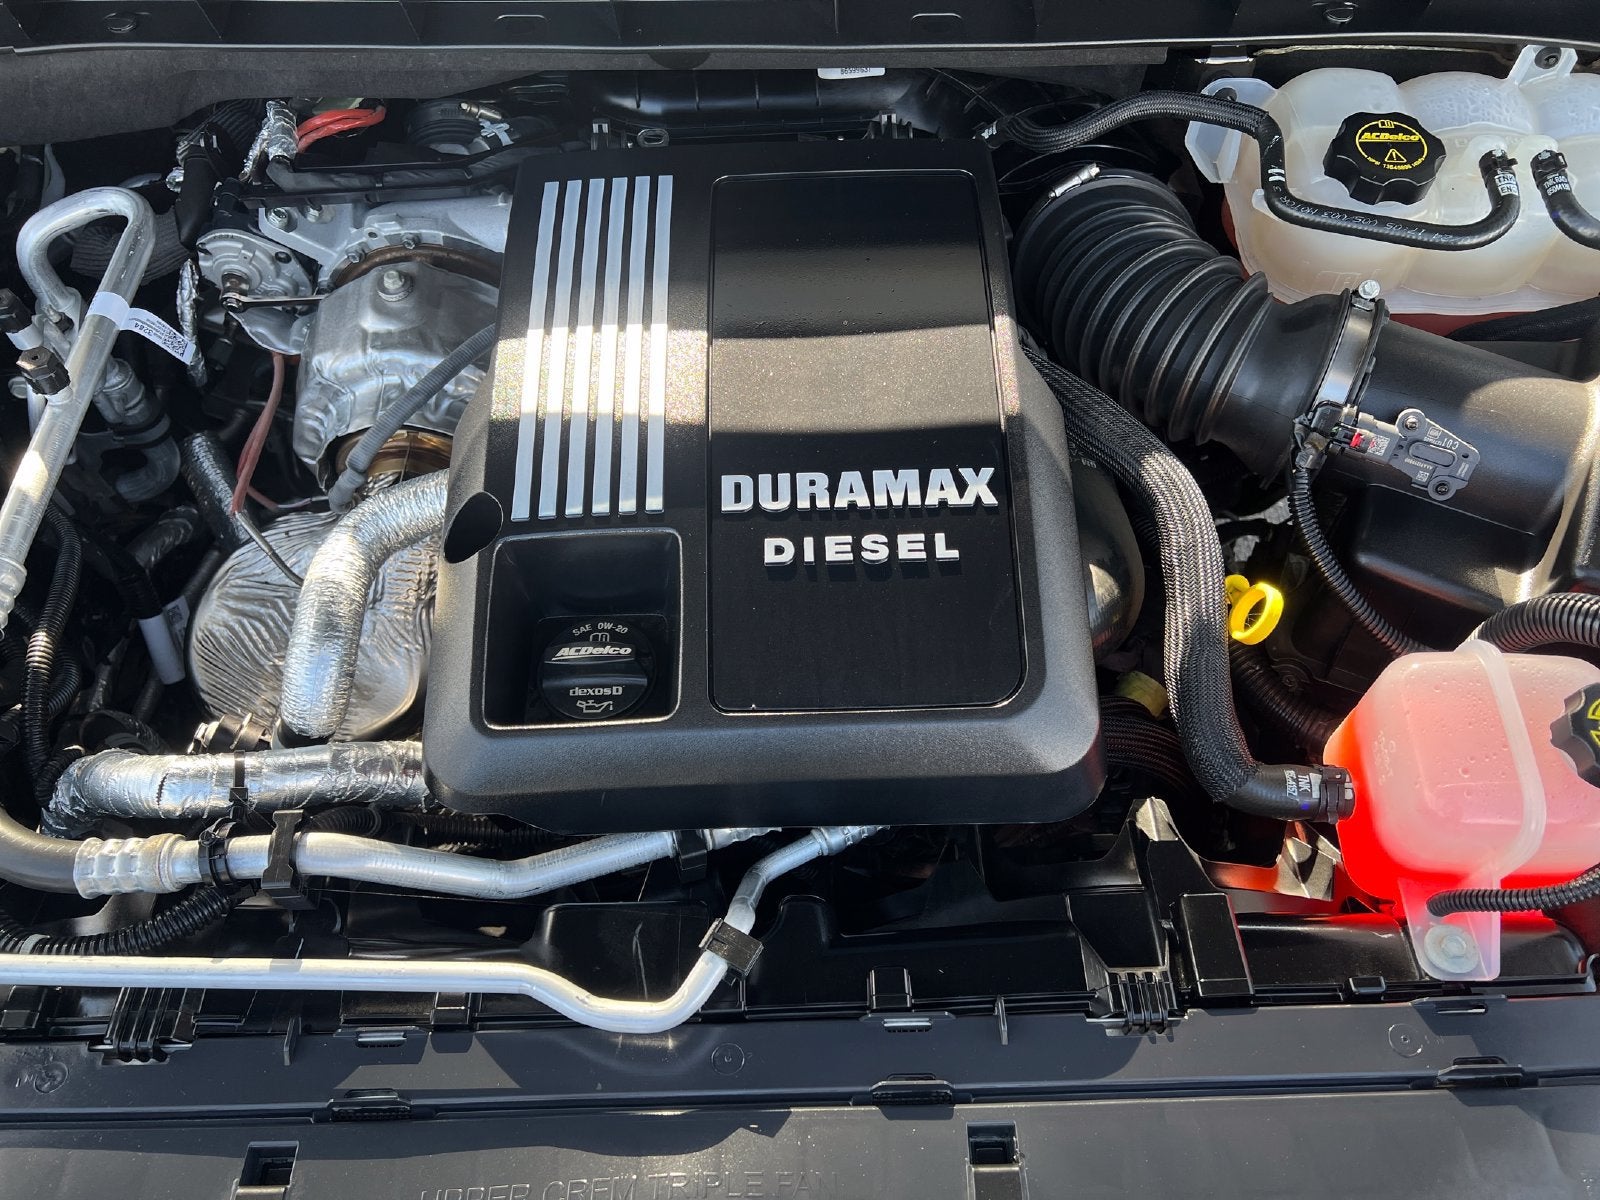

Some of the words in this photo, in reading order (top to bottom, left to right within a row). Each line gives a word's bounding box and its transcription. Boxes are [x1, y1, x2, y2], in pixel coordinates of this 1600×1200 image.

[1360, 132, 1420, 141] ACDelco
[721, 467, 999, 513] DURAMAX
[764, 532, 960, 566] DIESEL
[572, 623, 593, 637] SAE
[597, 621, 629, 634] 0W-20
[554, 645, 633, 657] ACDelco
[1297, 774, 1311, 793] TNK
[648, 1172, 765, 1200] TRIPLE
[776, 1171, 838, 1200] FAN
